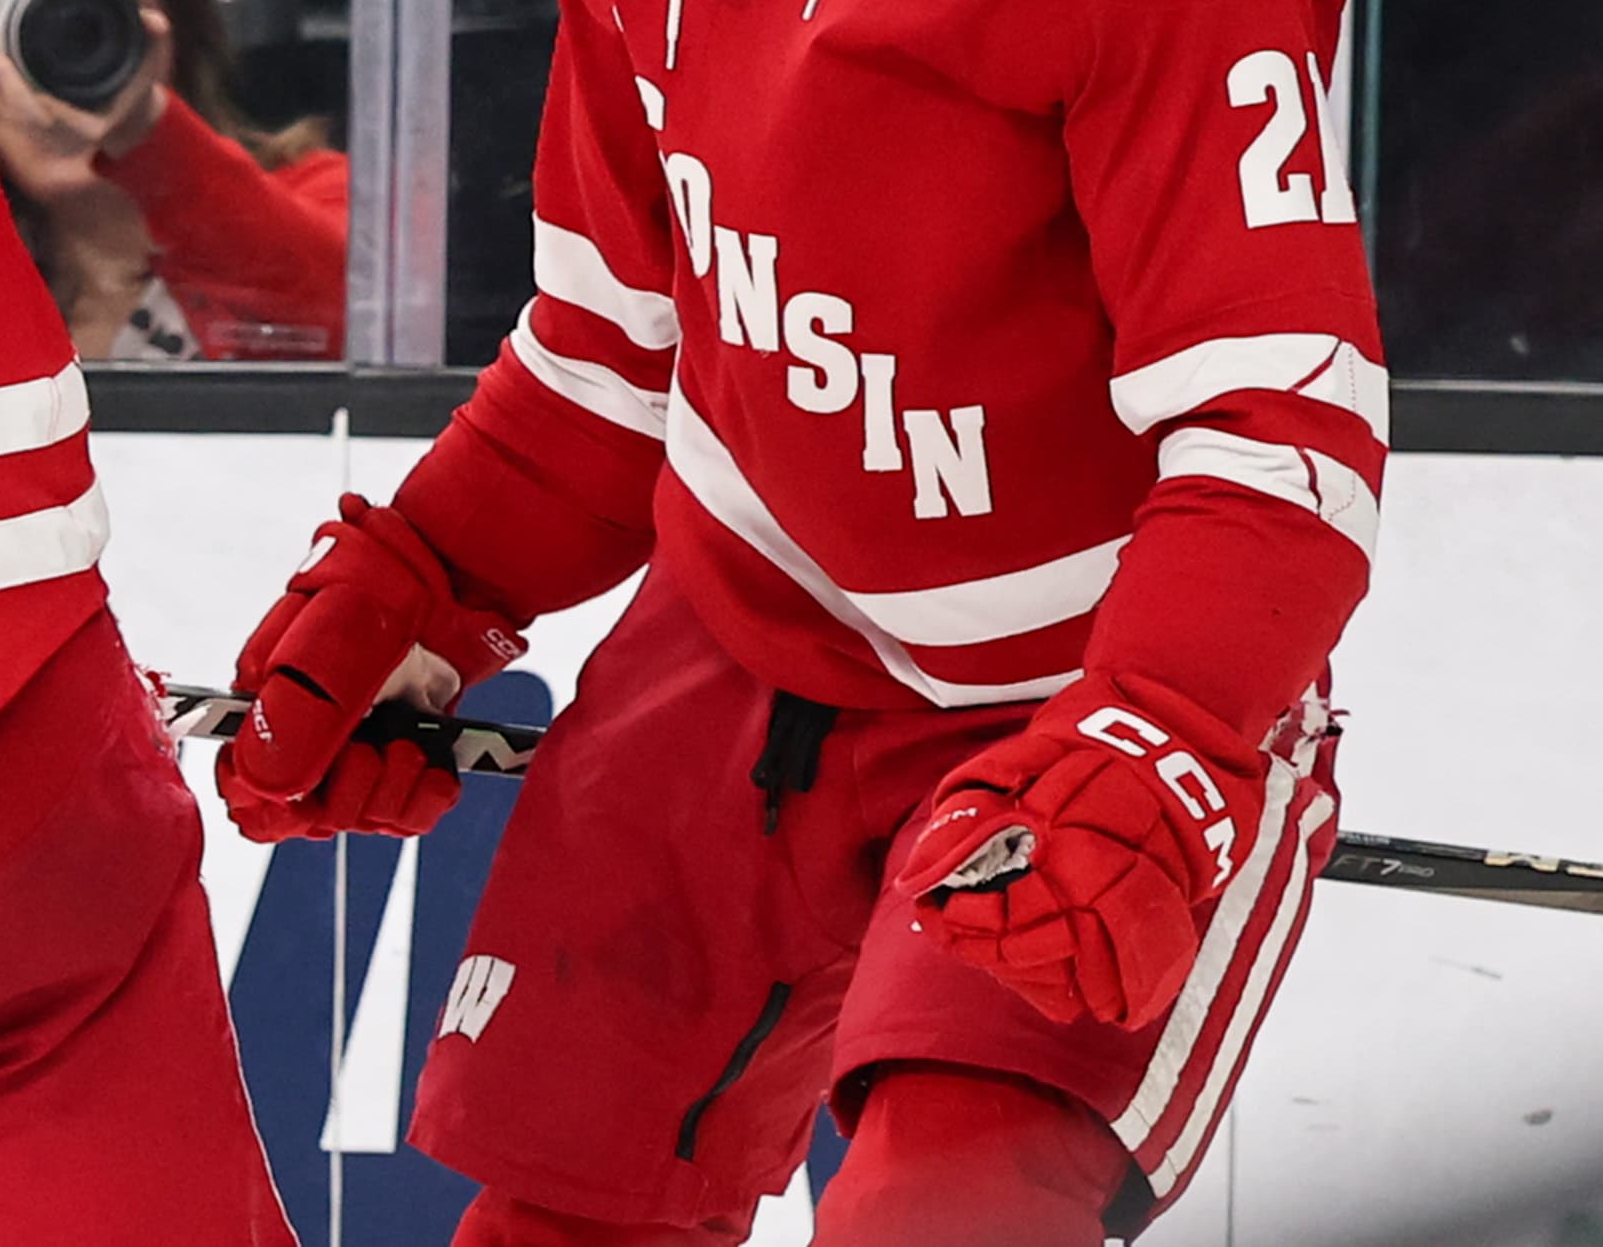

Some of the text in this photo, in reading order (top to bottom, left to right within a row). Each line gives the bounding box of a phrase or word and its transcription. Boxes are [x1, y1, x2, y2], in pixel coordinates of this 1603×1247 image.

[1227, 49, 1358, 230] 21
[1076, 706, 1238, 889] CCM
[438, 955, 516, 1044] W
